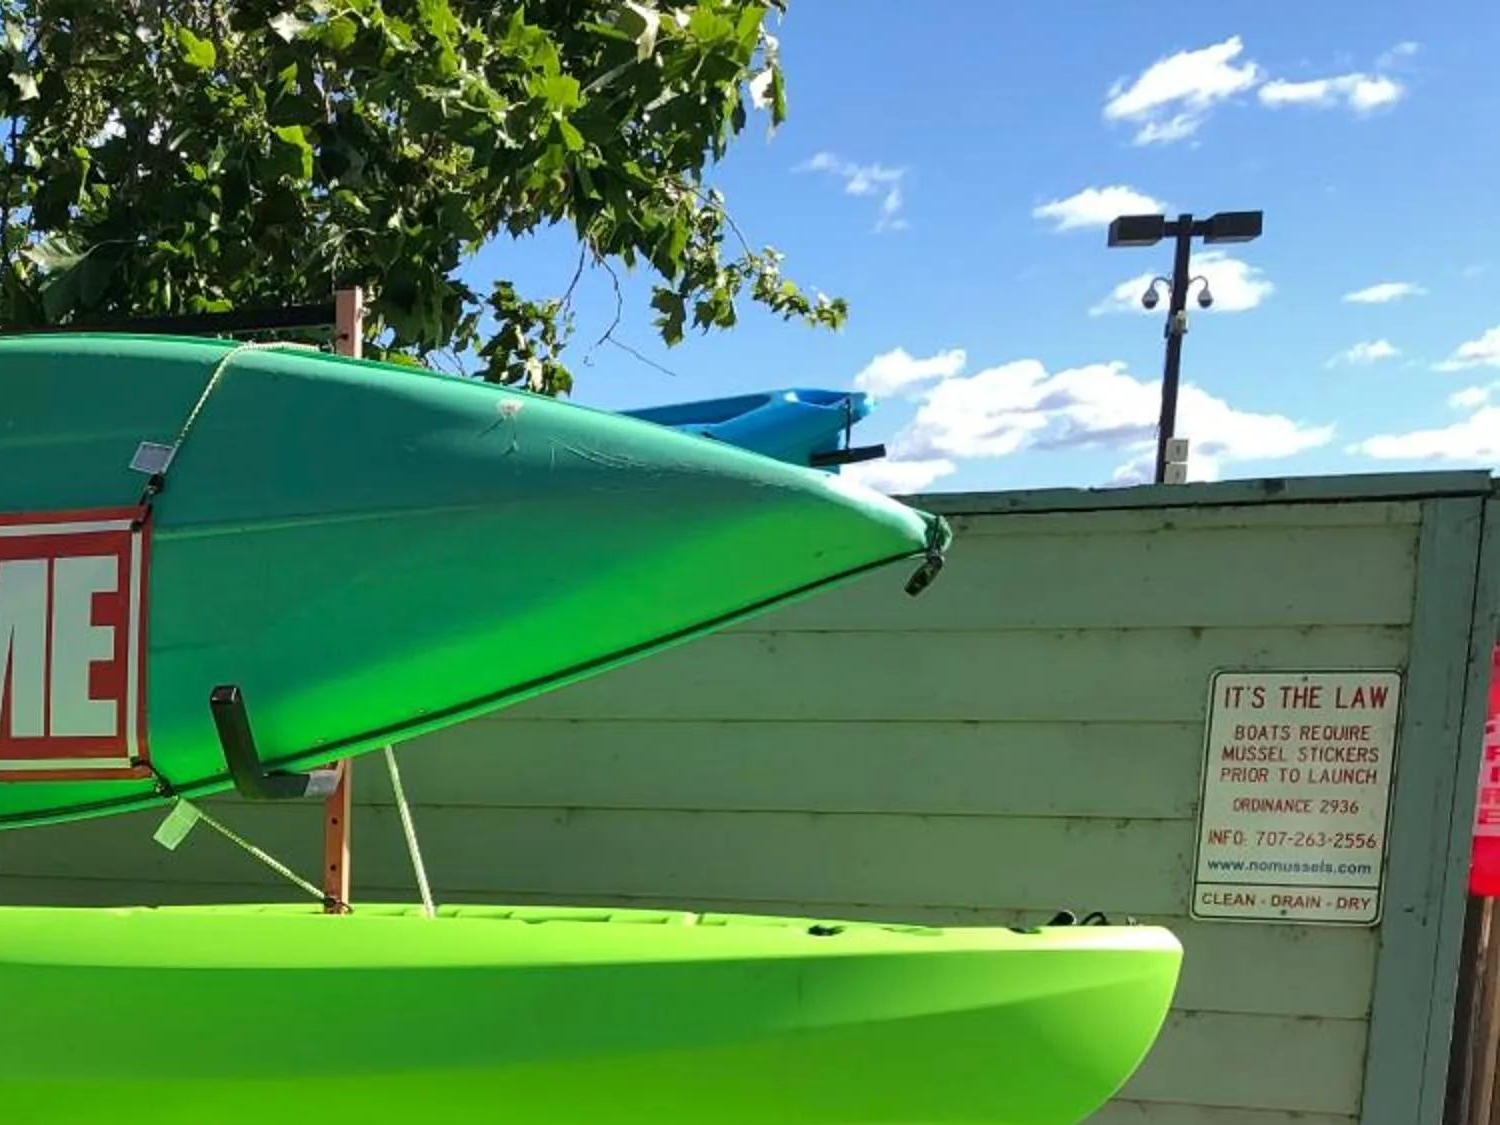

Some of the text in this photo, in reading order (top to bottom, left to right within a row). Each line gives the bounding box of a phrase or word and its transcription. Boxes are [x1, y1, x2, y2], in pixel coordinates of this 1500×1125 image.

[1224, 686, 1388, 709] IT'S THE LAW
[1234, 725, 1372, 741] BOATS REQUIRE
[1221, 746, 1379, 763] MUSSEL STICKERS
[1220, 767, 1377, 784] PRIOR TO LAUNCH
[1233, 798, 1359, 814] ORDINANCE 2936
[1256, 831, 1377, 849] 707-263-2556
[1207, 860, 1372, 874] www.nomussels.com
[1201, 893, 1257, 907] CLEAN
[1270, 894, 1321, 908] DRAIN
[1336, 896, 1371, 910] DRY
